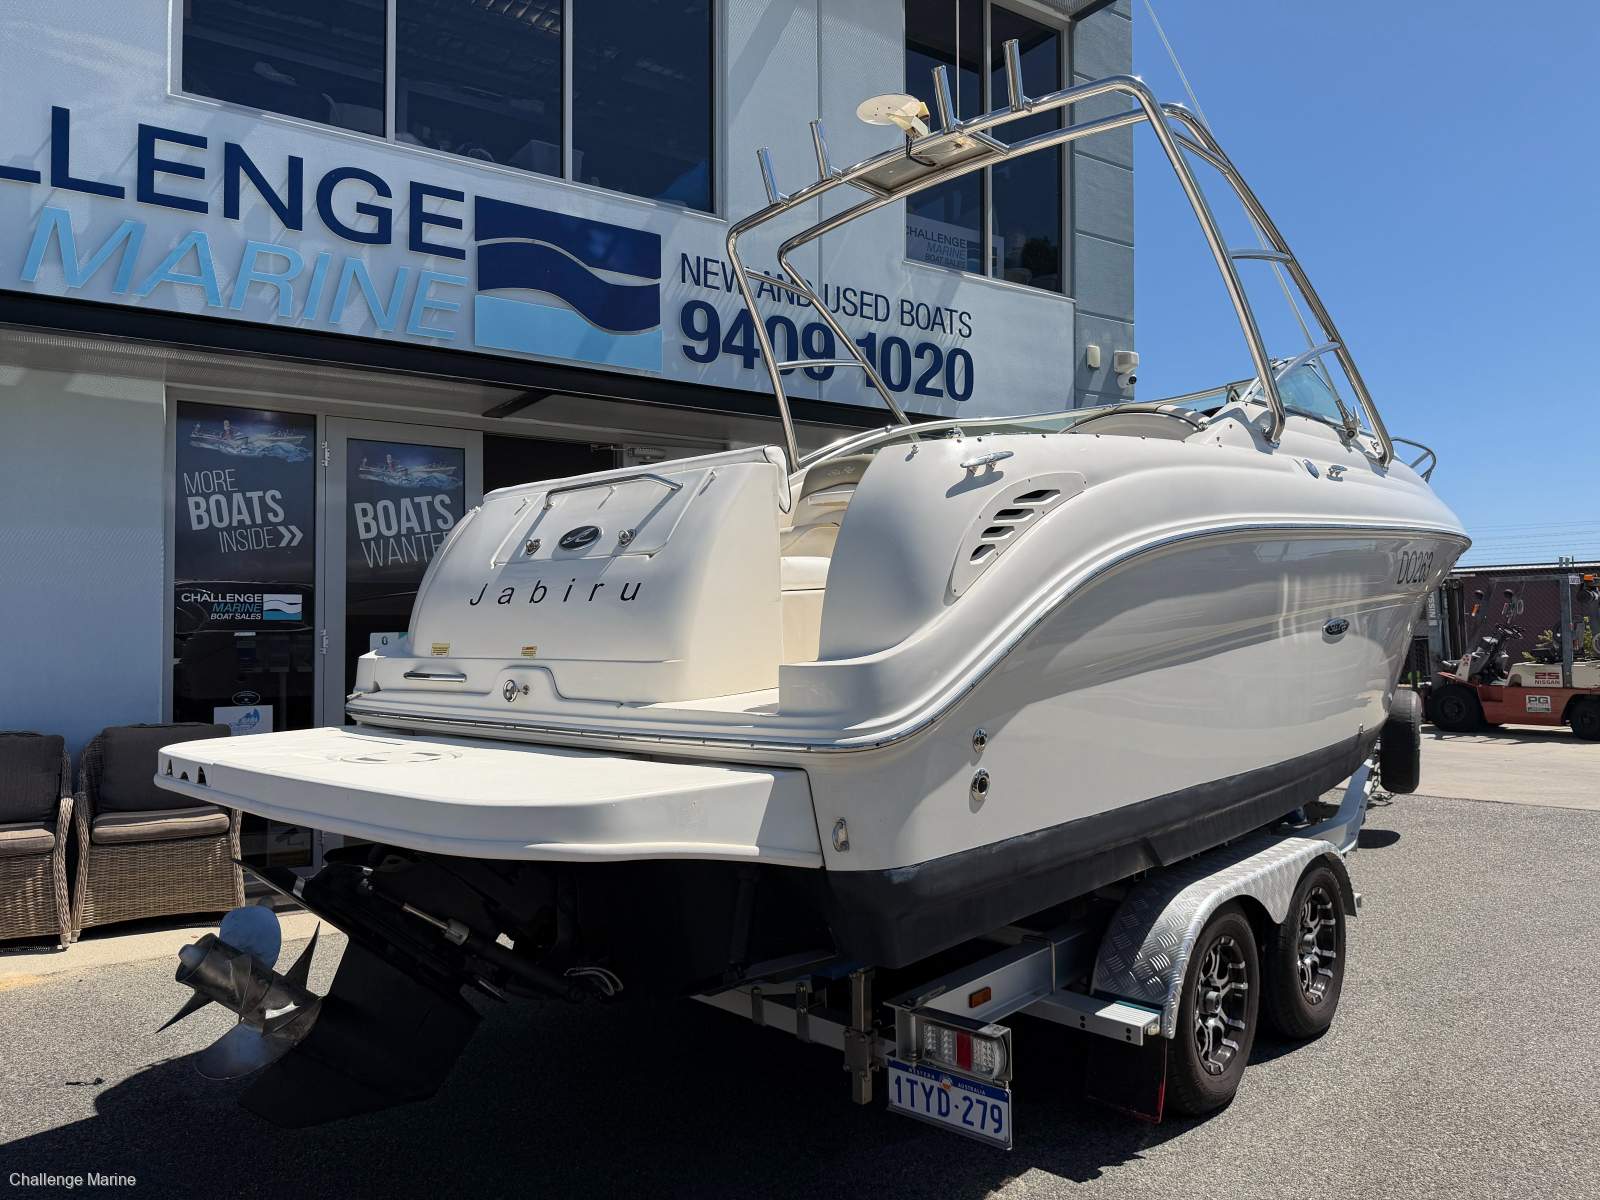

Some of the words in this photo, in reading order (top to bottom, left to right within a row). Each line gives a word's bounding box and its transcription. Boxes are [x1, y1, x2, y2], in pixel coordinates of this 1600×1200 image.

[0, 105, 466, 260] LENGE
[925, 253, 944, 263] BOAT
[927, 242, 967, 260] MARINE
[20, 206, 469, 340] MARINE
[681, 252, 749, 295] NEW
[757, 271, 815, 307] AND
[824, 284, 890, 322] USED
[900, 299, 972, 338] BOATS
[680, 300, 836, 381] 9409
[856, 332, 974, 401] 1020
[184, 469, 238, 494] MORE
[187, 490, 285, 531] BOATS
[354, 494, 454, 540] BOATS
[219, 527, 277, 553] INSIDE
[361, 532, 448, 569] WANTE
[181, 593, 262, 603] CHALLENGE
[212, 603, 262, 613] MARINE
[469, 578, 642, 606] Jabiru
